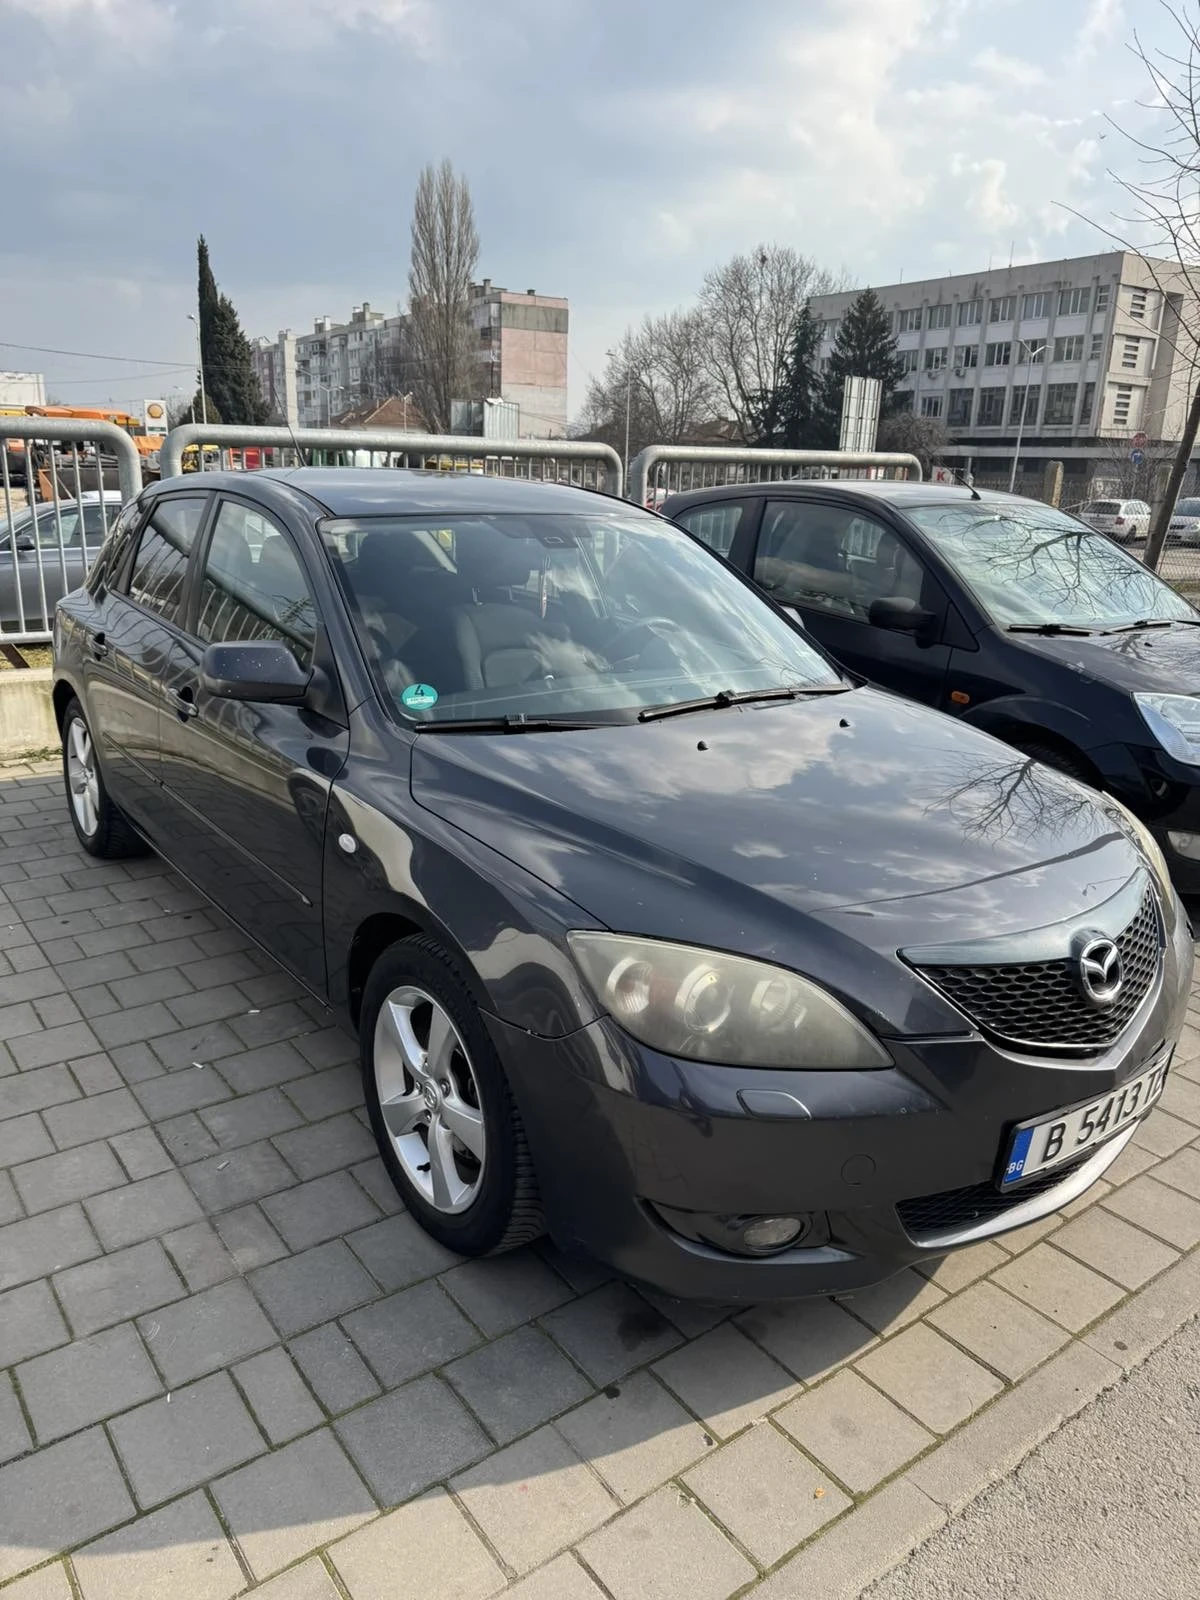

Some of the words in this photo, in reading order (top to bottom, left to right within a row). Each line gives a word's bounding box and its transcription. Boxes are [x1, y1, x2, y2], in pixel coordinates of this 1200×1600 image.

[414, 684, 425, 696] 4
[1041, 1122, 1066, 1164] B
[1075, 1081, 1142, 1146] 5413
[1008, 1160, 1024, 1174] BG
